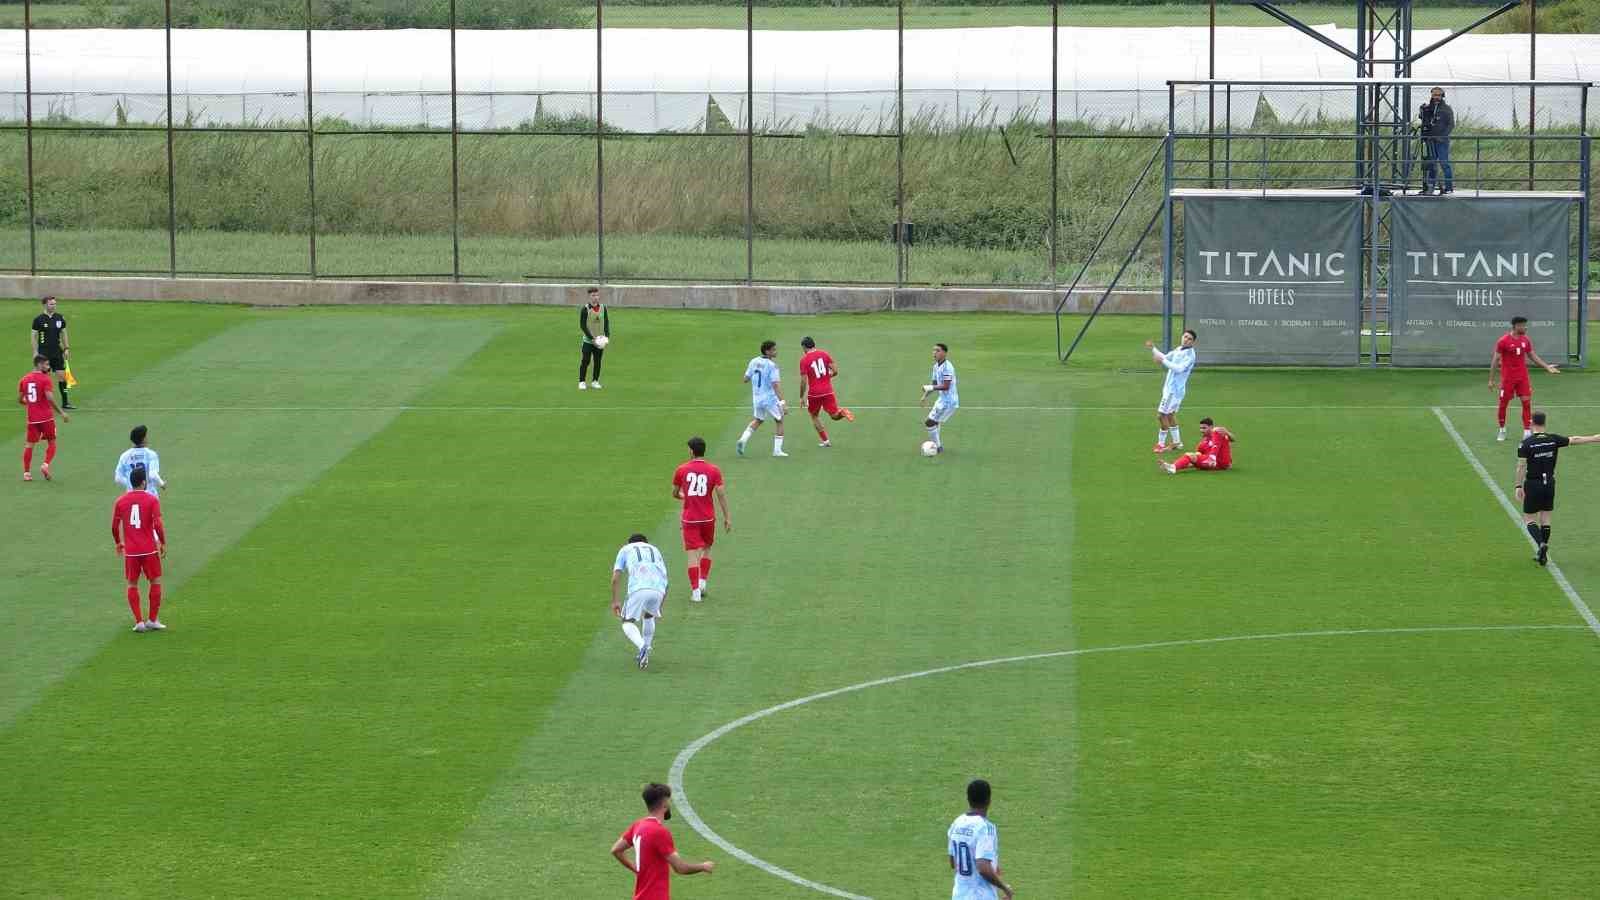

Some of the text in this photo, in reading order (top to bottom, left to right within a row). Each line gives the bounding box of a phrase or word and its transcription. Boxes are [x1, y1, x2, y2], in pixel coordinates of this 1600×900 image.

[1199, 250, 1346, 277] TITANIC
[1406, 250, 1555, 277] TITANIC
[1249, 288, 1296, 306] HOTELS
[1456, 289, 1503, 306] HOTELS
[754, 369, 762, 388] 7
[811, 357, 826, 379] 14
[27, 382, 38, 403] 5
[686, 472, 708, 497] 28
[129, 503, 141, 529] 4
